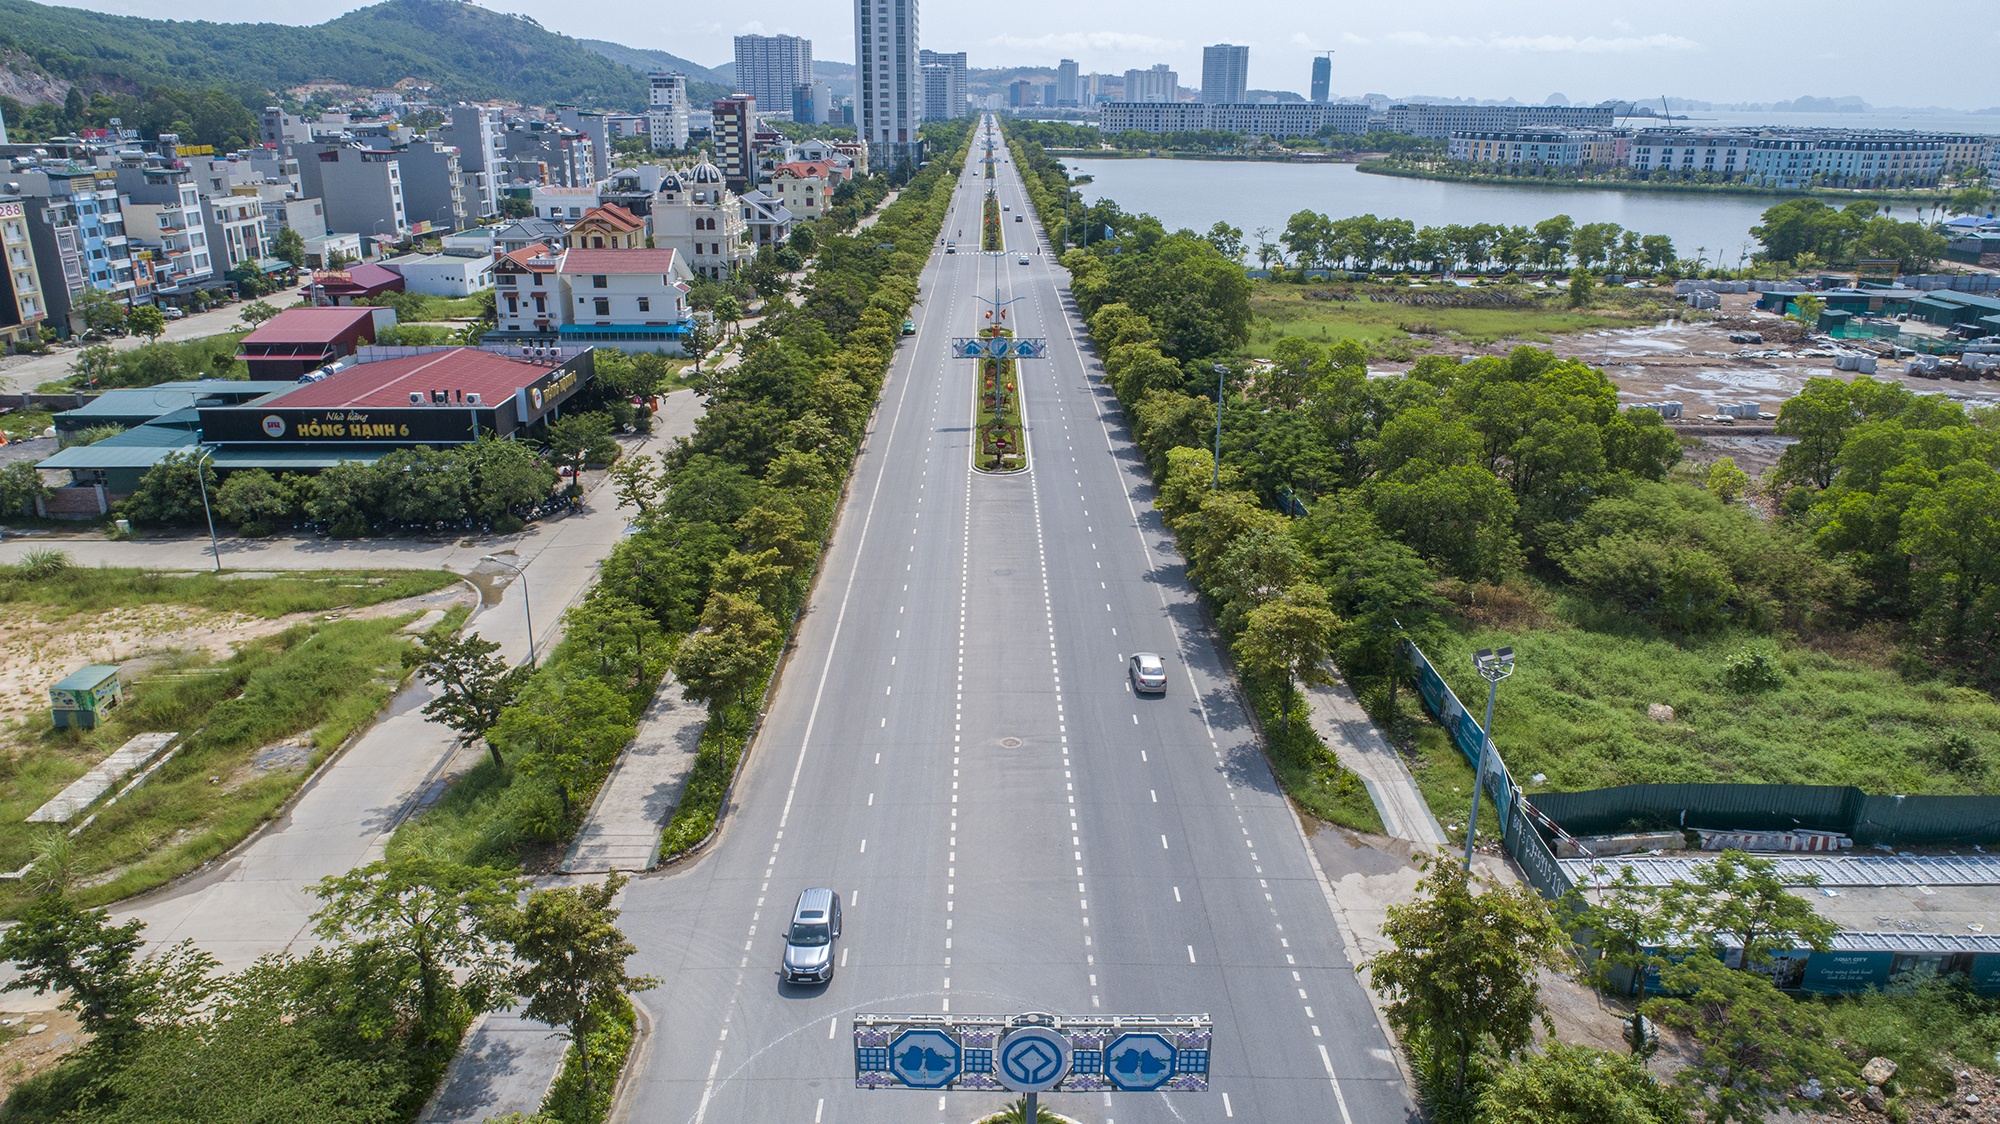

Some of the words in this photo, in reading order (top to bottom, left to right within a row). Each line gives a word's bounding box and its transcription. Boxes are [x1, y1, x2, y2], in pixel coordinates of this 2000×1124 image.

[326, 411, 345, 421] Nhà
[346, 410, 368, 423] hàng
[297, 418, 345, 437] HỒNG
[350, 423, 396, 439] HẠNH
[399, 424, 410, 437] 6
